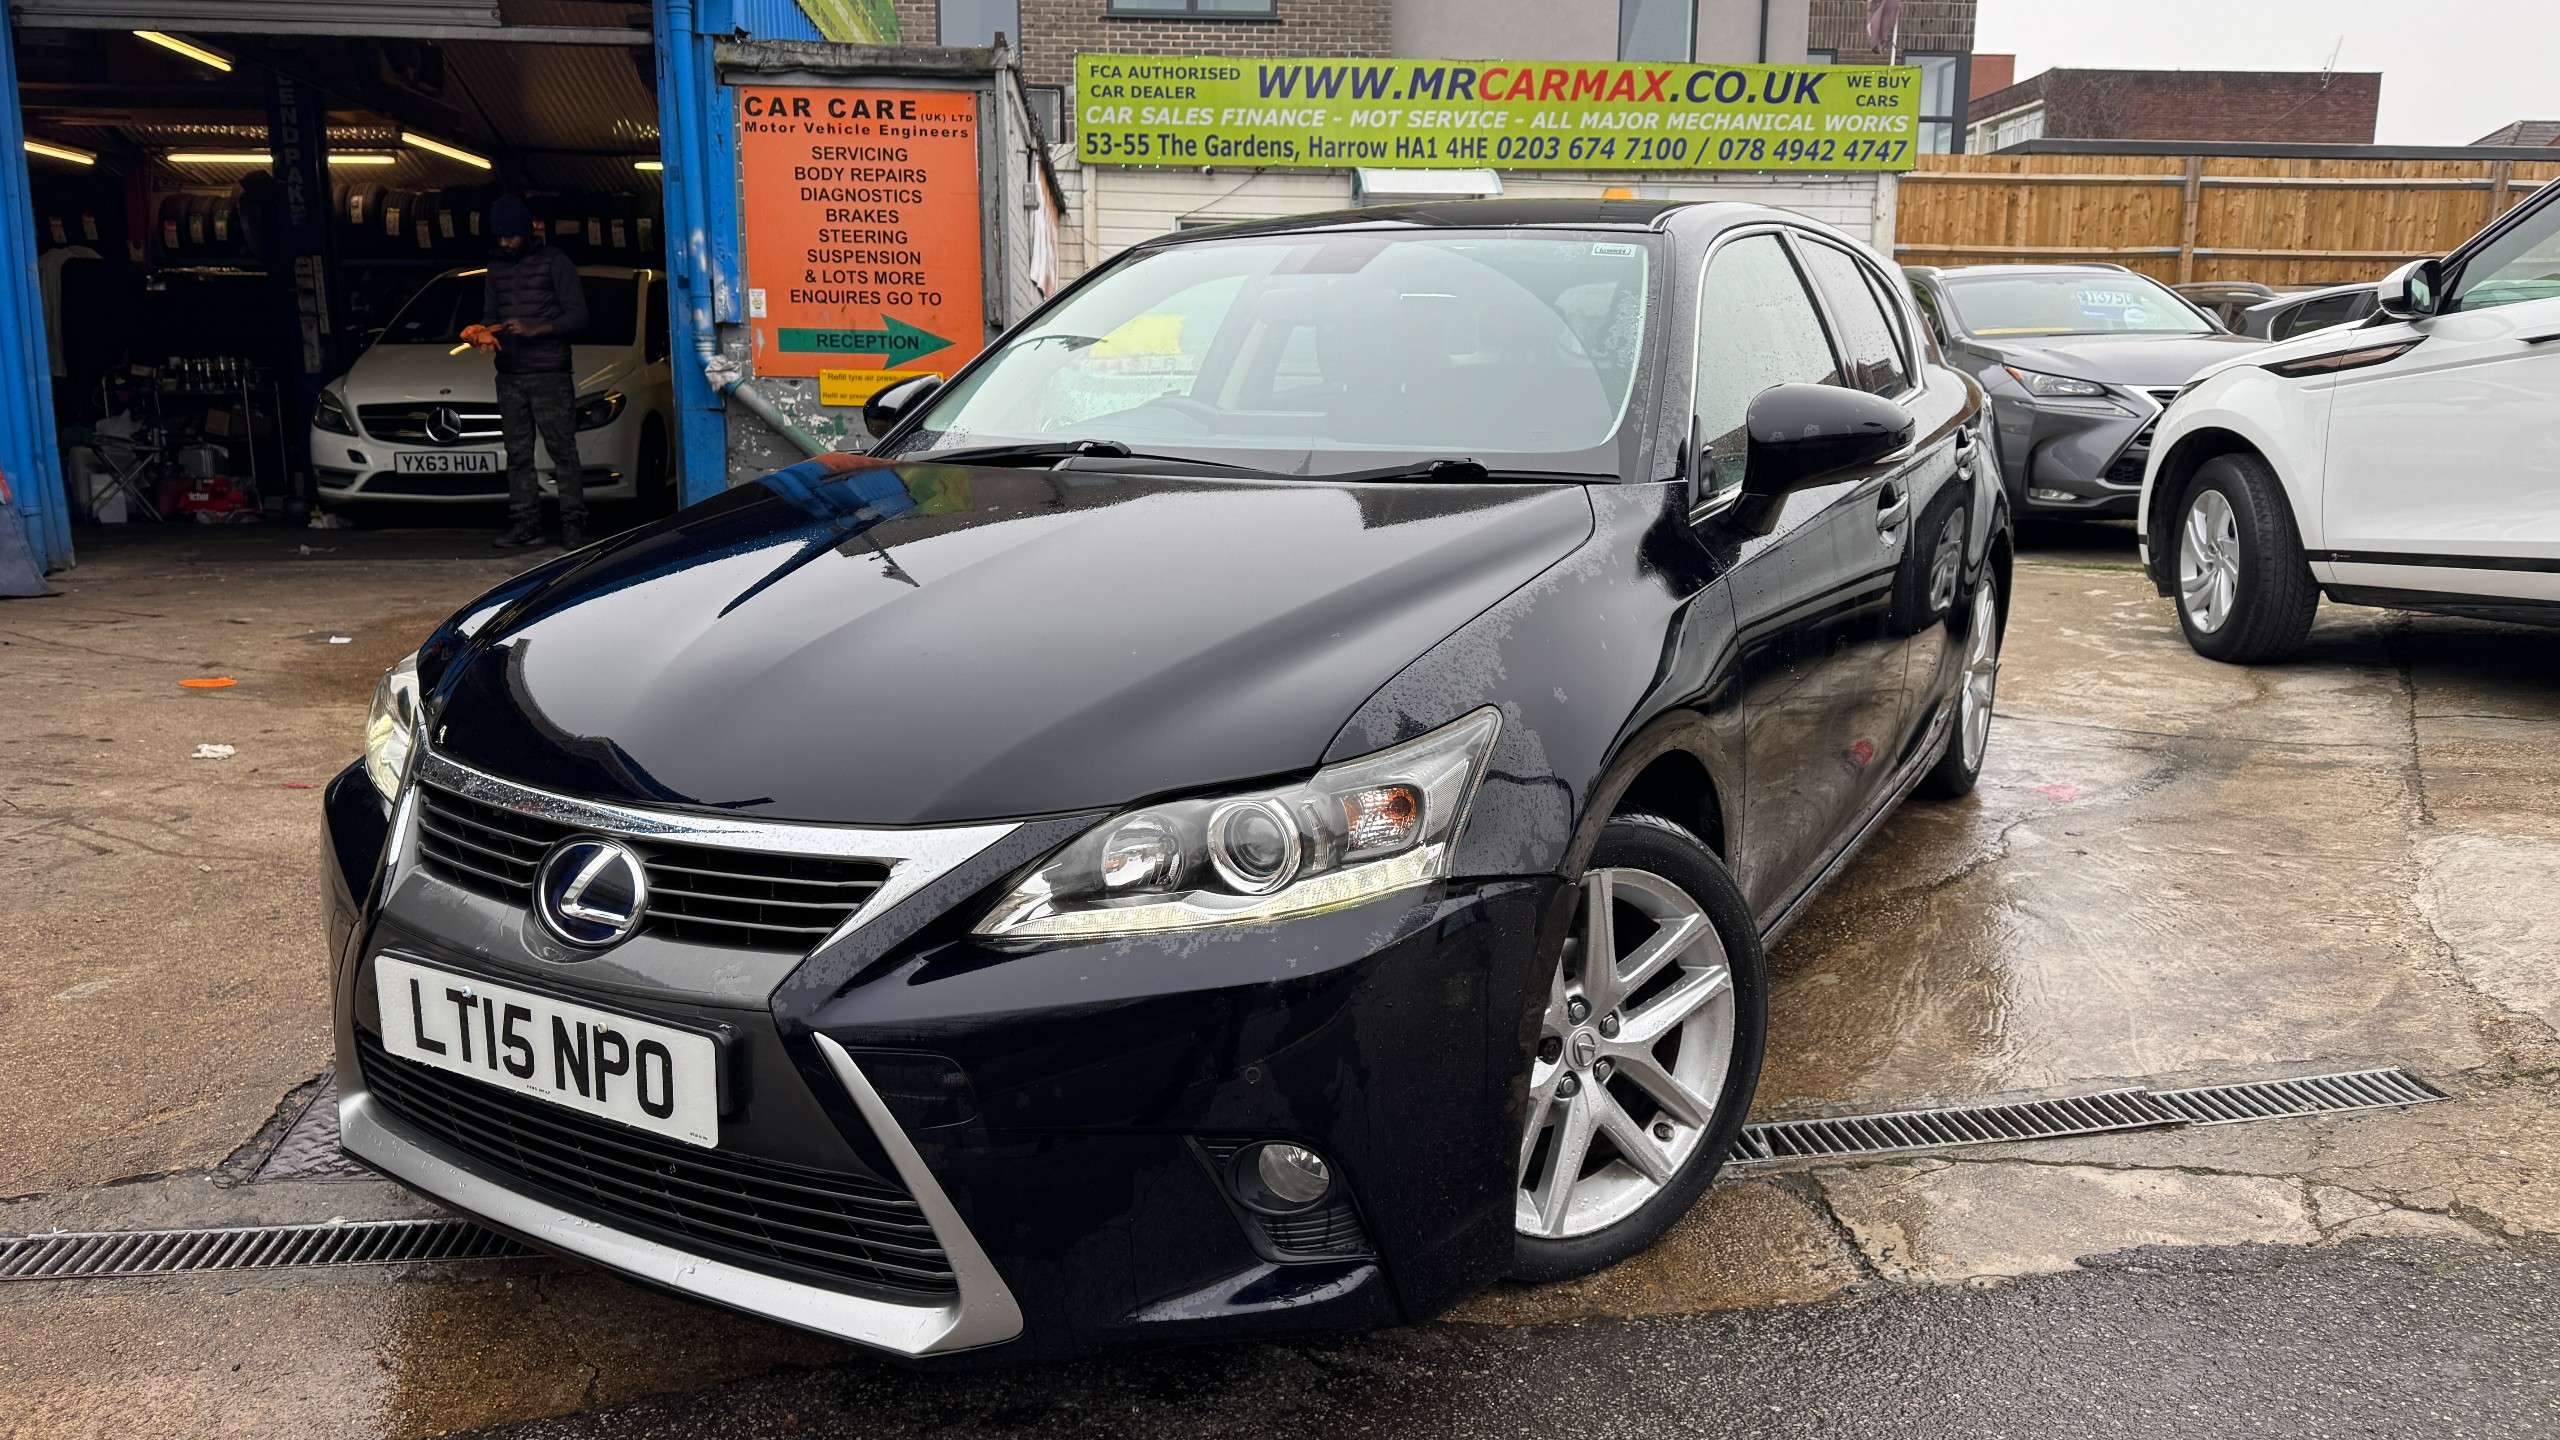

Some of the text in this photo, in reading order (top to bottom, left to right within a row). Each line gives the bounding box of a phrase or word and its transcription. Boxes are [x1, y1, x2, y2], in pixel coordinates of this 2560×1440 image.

[1090, 65, 1240, 80] FCA AUTHORISED
[1259, 65, 1827, 104] WWW.MRCARMAX.CO.UK
[1847, 76, 1911, 89] WE BUY
[1090, 85, 1196, 99] CAR DEALER
[1856, 95, 1898, 107] CARS
[744, 96, 973, 123] CAR CARE (UK) LTD
[1086, 106, 1133, 124] CAR
[1141, 107, 1214, 126] SALES
[1221, 108, 1326, 127] FINANCE
[1350, 110, 1403, 128] MOT
[1407, 110, 1508, 129] SERVICE
[1530, 112, 1572, 129] ALL
[1580, 112, 1658, 130] MAJOR
[1666, 113, 1815, 131] MECHANICAL
[1825, 114, 1909, 133] WORKS
[744, 122, 969, 139] Motor Vehicle Engineers
[811, 146, 908, 161] SERVICING
[1086, 132, 1908, 165] 53-55 The Gardens, Harrow HA1 4HE 0203 674 7100 / 078 4942 4747
[794, 167, 926, 183] BODY REPAIRS
[801, 187, 922, 203] DIAGNOSTICS
[826, 209, 899, 223] BRAKES
[818, 228, 908, 244] STEERING
[807, 250, 921, 265] SUSPENSION
[804, 270, 925, 285] & LOTS MORE
[790, 290, 942, 305] ENQUIRES GO TO
[816, 333, 920, 350] RECEPTION
[403, 455, 489, 471] YX63 HUA
[410, 978, 674, 1120] LT15 NPO
